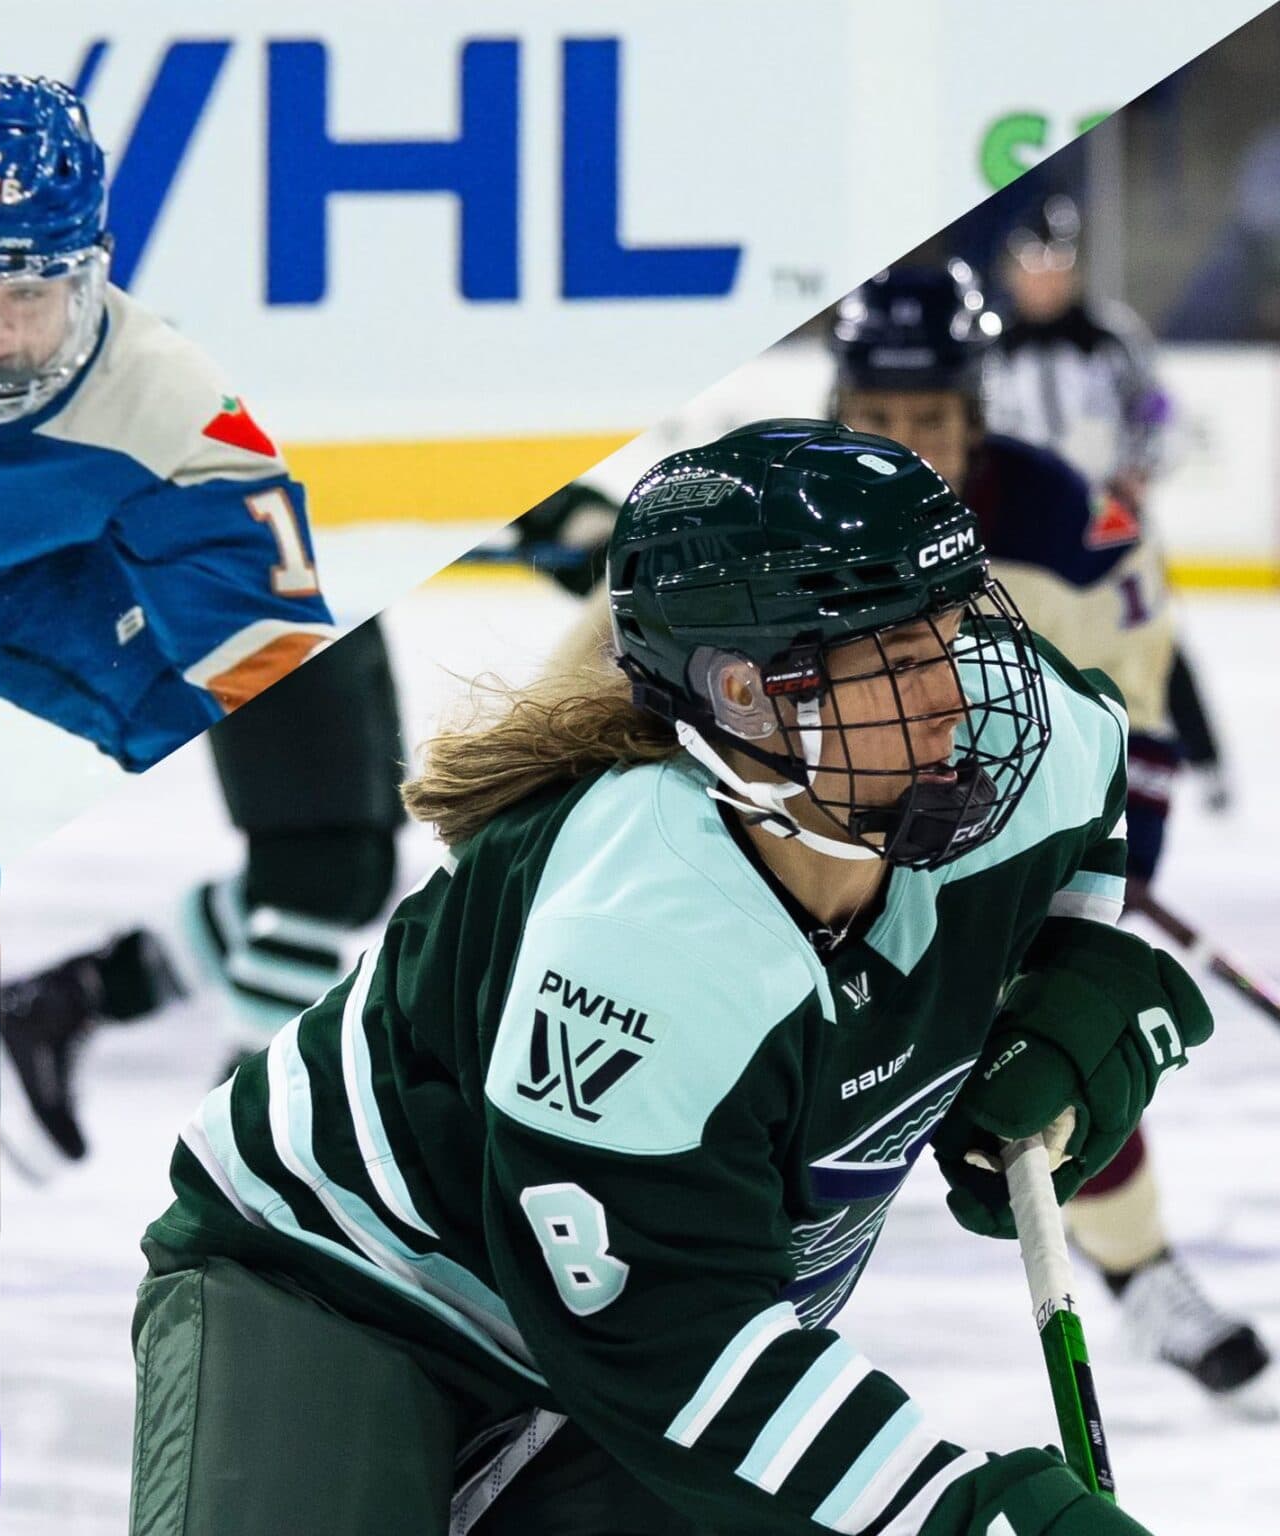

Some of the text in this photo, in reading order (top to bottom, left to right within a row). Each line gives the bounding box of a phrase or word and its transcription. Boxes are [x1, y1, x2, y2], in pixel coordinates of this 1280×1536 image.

[632, 480, 739, 520] FLEET
[918, 526, 975, 569] CCM
[538, 968, 656, 1044] PWHL
[519, 1182, 629, 1317] 8
